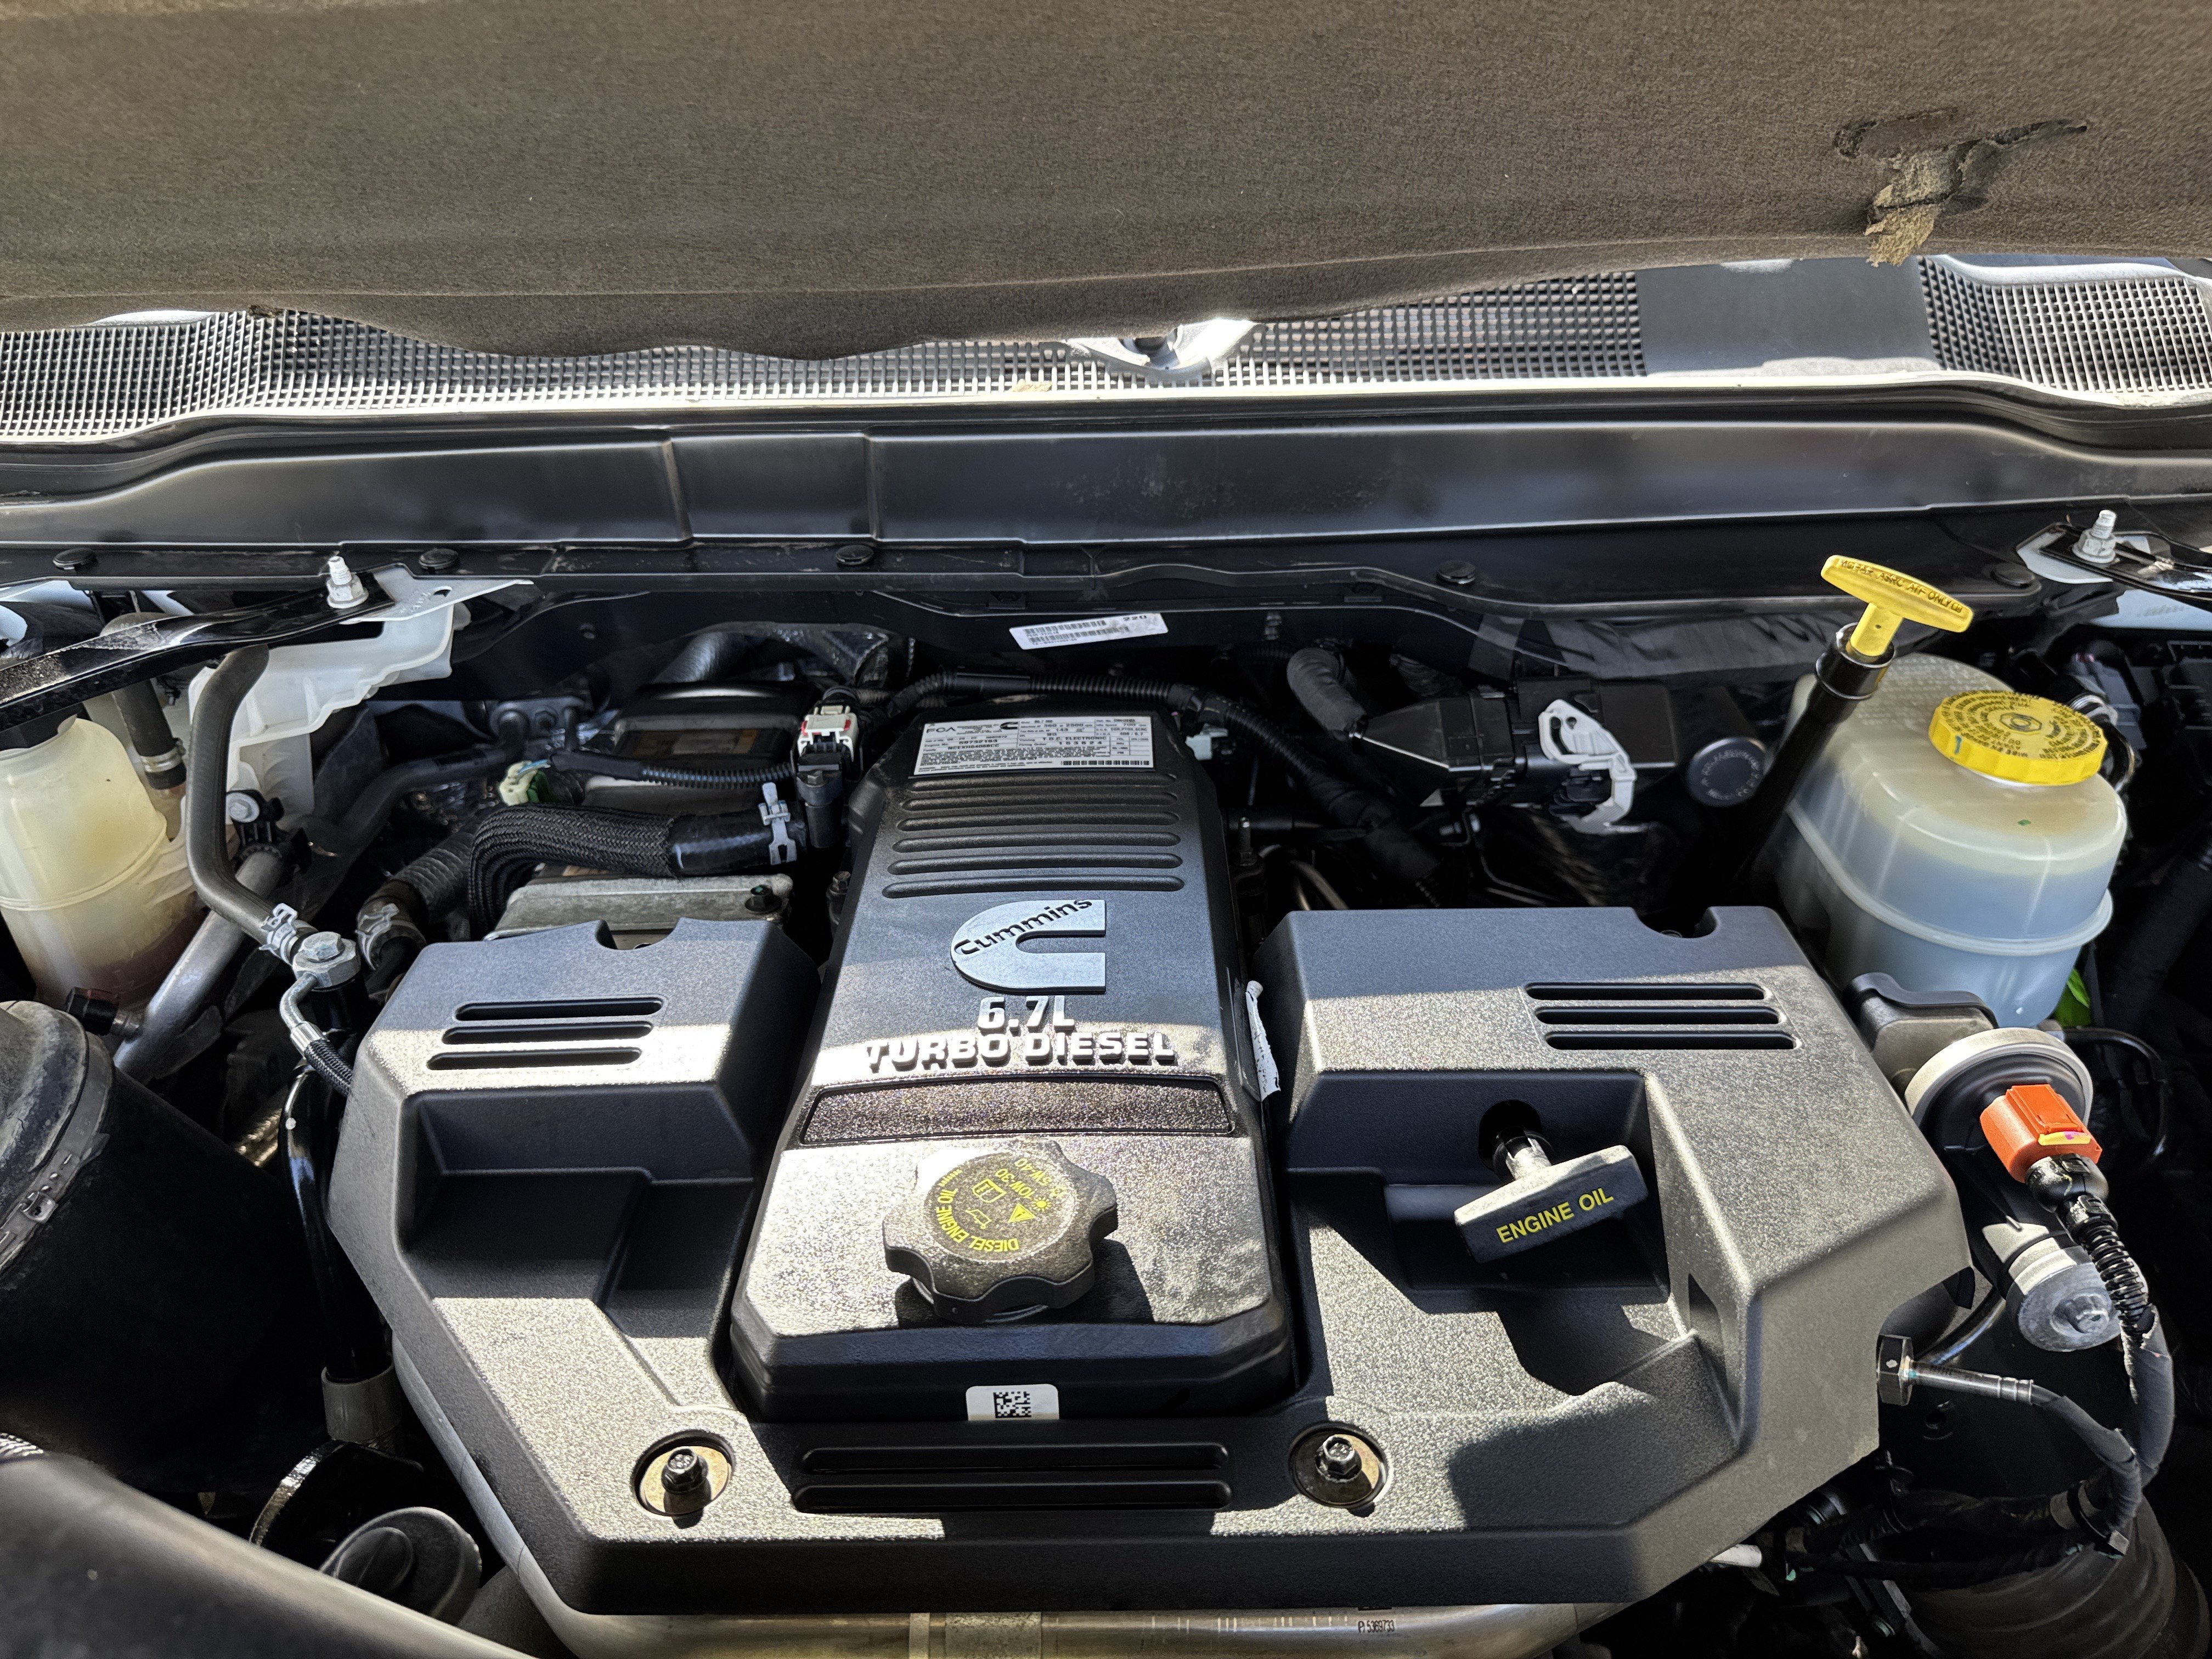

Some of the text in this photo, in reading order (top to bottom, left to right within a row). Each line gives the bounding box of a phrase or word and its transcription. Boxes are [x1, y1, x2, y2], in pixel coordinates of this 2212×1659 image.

[1905, 582, 1928, 595] ATF
[1927, 591, 1953, 608] ONLY
[954, 899, 1092, 955] Cummins
[977, 995, 1075, 1032] 6.7L
[865, 1031, 1177, 1071] TURBO DIESEL
[995, 1168, 1035, 1199] 10W-30
[1014, 1158, 1053, 1186] 5W-40
[937, 1187, 959, 1204] OIL
[935, 1205, 970, 1243] ENGINE
[1496, 1187, 1614, 1244] ENGINE OIL
[968, 1235, 1019, 1252] DIESEL
[1367, 1620, 1395, 1633] 5369733
